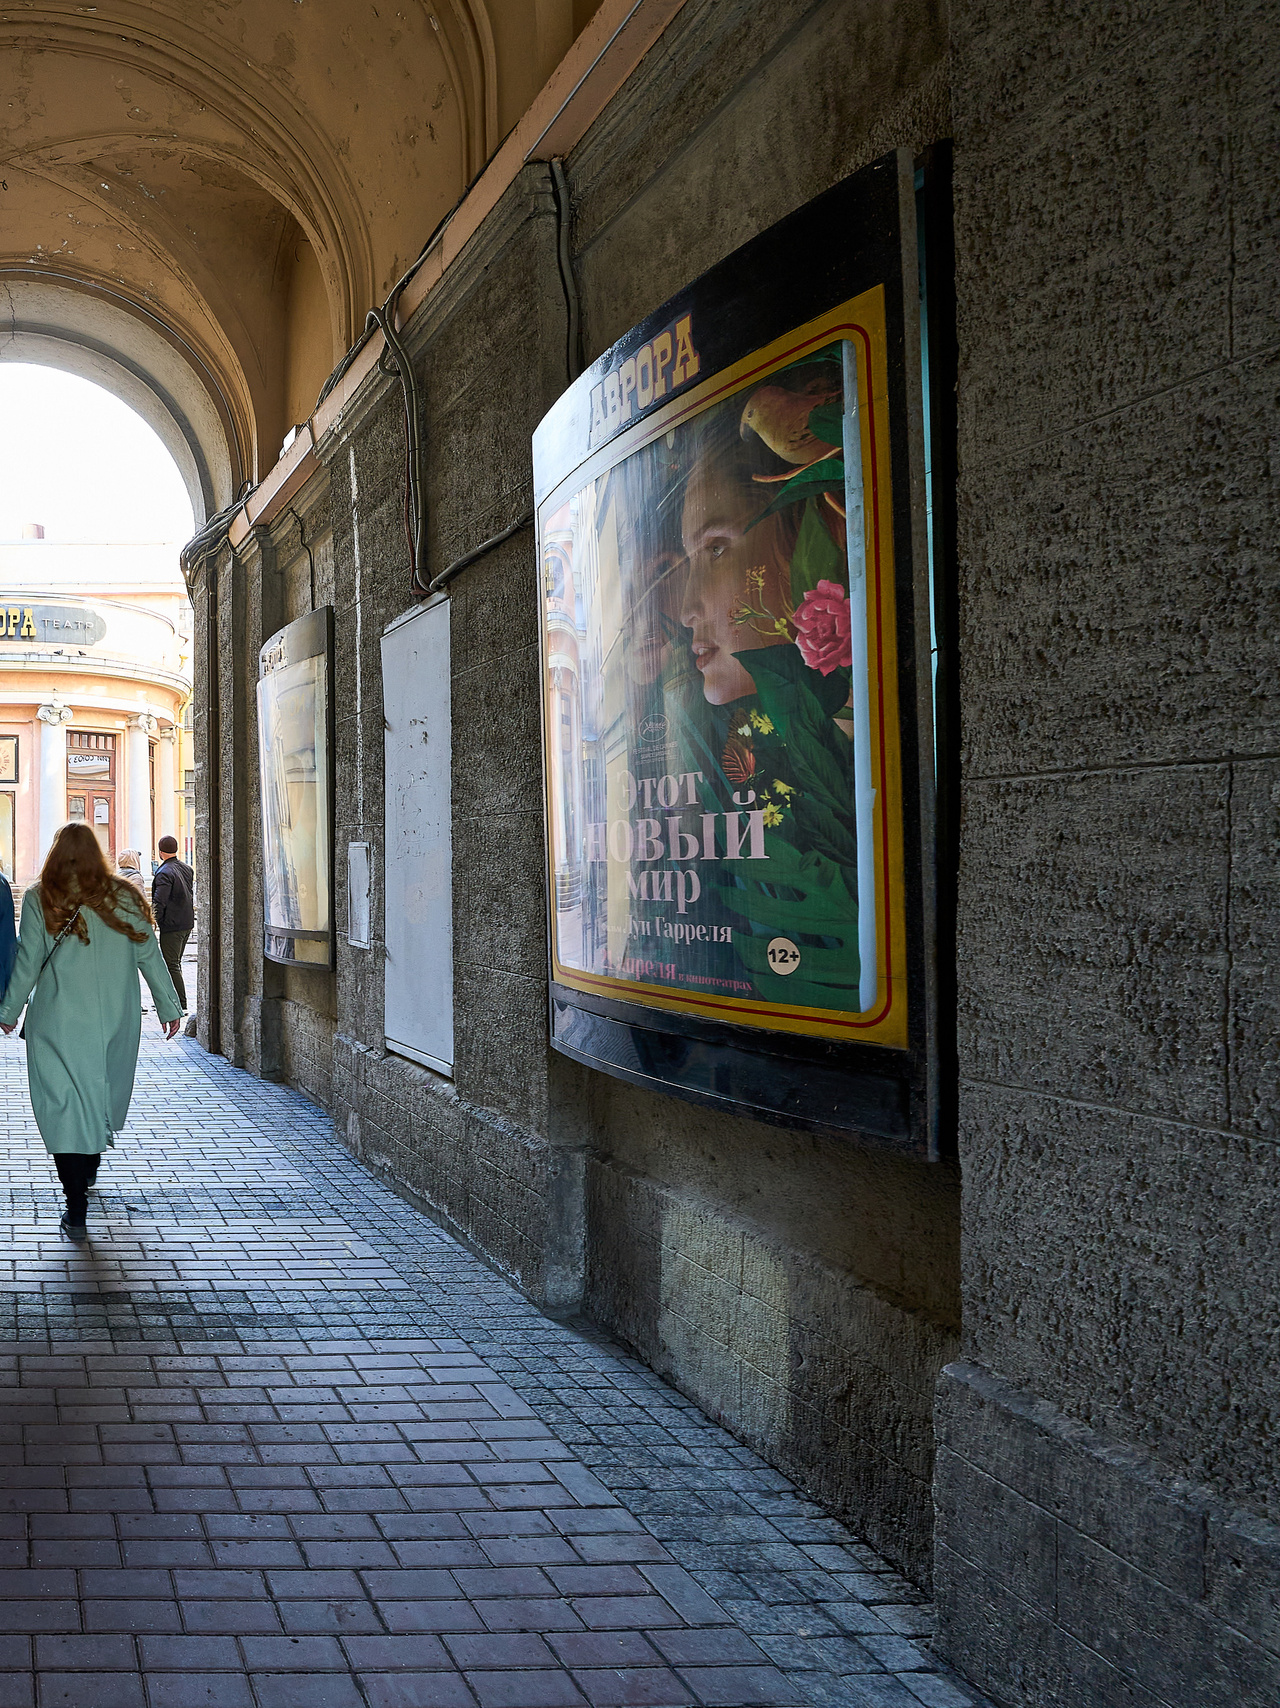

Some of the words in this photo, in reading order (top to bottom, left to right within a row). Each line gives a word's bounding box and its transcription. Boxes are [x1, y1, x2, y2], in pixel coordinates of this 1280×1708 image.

[588, 313, 700, 450] АВРОРА
[41, 618, 95, 630] ТЕАТР
[616, 769, 703, 812] Этот
[586, 789, 770, 863] новый
[624, 868, 701, 915] мир
[655, 916, 733, 945] Гарреля
[768, 948, 799, 963] 12+
[686, 974, 753, 992] кинотеатрах
